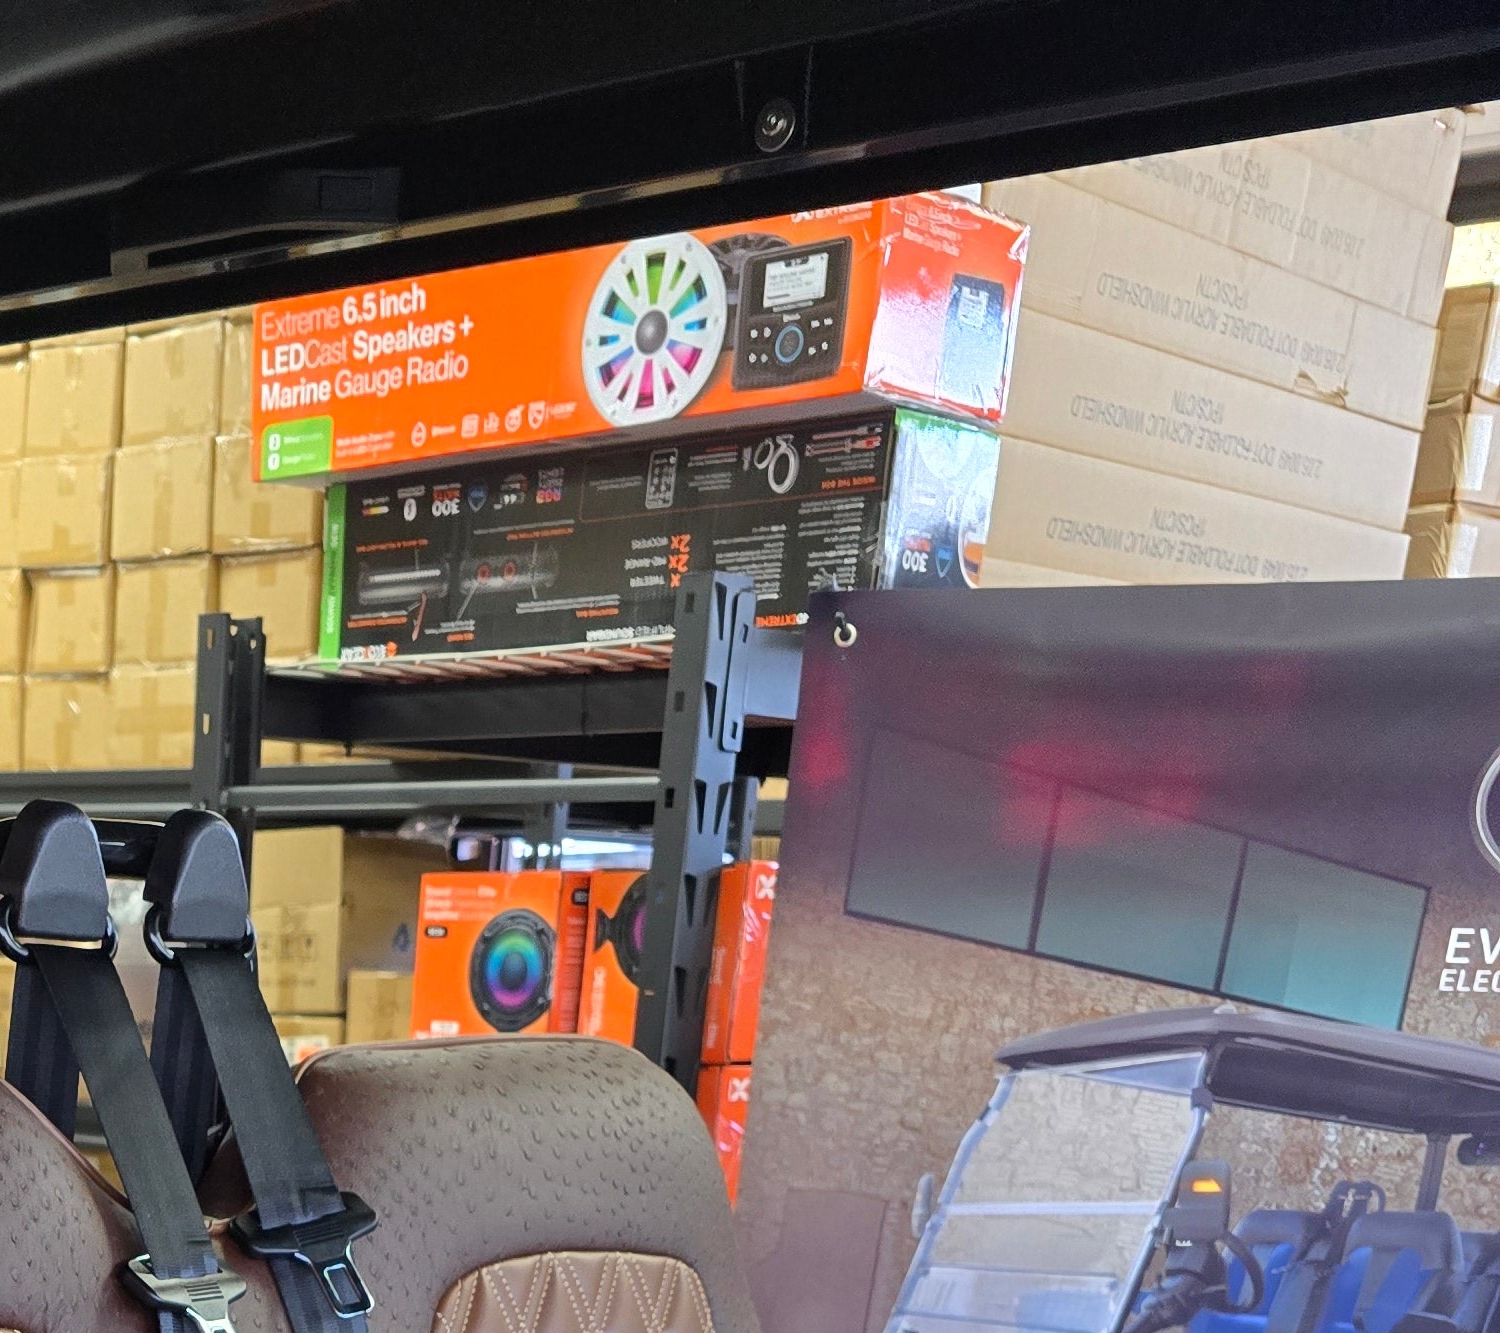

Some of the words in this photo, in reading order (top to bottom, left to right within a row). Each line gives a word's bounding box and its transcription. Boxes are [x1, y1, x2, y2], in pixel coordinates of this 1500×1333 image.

[261, 305, 340, 342] Extreme
[342, 290, 377, 326] 6.5
[380, 282, 426, 318] inch
[1096, 272, 1171, 318] WINDSHIELD
[1171, 296, 1219, 331] ACRYLIC
[261, 337, 348, 377] LEDCast
[352, 319, 456, 363] Speakers
[1220, 313, 1275, 351] FOLDABLE
[1275, 334, 1298, 359] DOT
[261, 378, 331, 412] Marine
[335, 366, 403, 398] Gauge
[406, 349, 469, 386] Radio
[1070, 395, 1146, 433] WINDSHIELD
[1146, 414, 1196, 447] ACRYLIC
[1195, 426, 1252, 462] FOLDABLE
[432, 498, 461, 517] 300
[1045, 518, 1124, 554] WINDSHIELD
[1124, 531, 1175, 559] ACRYLIC
[902, 550, 929, 573] 300
[1175, 541, 1234, 572] FOLDABLE
